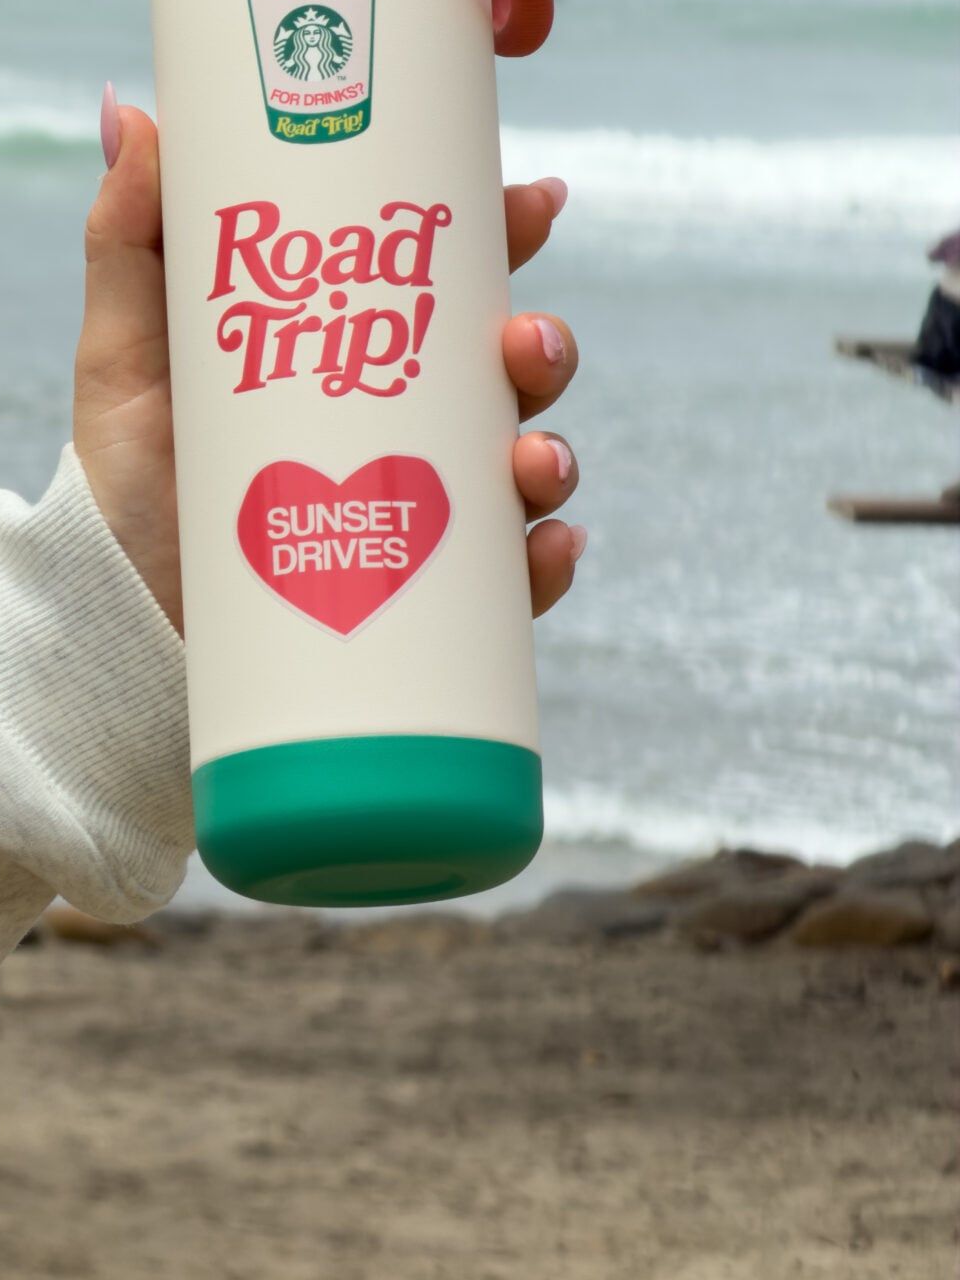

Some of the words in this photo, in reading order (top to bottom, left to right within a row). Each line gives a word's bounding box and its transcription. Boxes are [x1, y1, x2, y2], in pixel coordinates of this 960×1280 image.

[270, 88, 300, 106] FOR
[304, 82, 365, 107] DRINKS?
[275, 115, 320, 138] Road
[321, 110, 364, 137] Trip!
[206, 200, 453, 302] Road
[216, 290, 436, 398] Trip!
[266, 500, 417, 540] SUNSET
[271, 536, 409, 576] DRIVES
